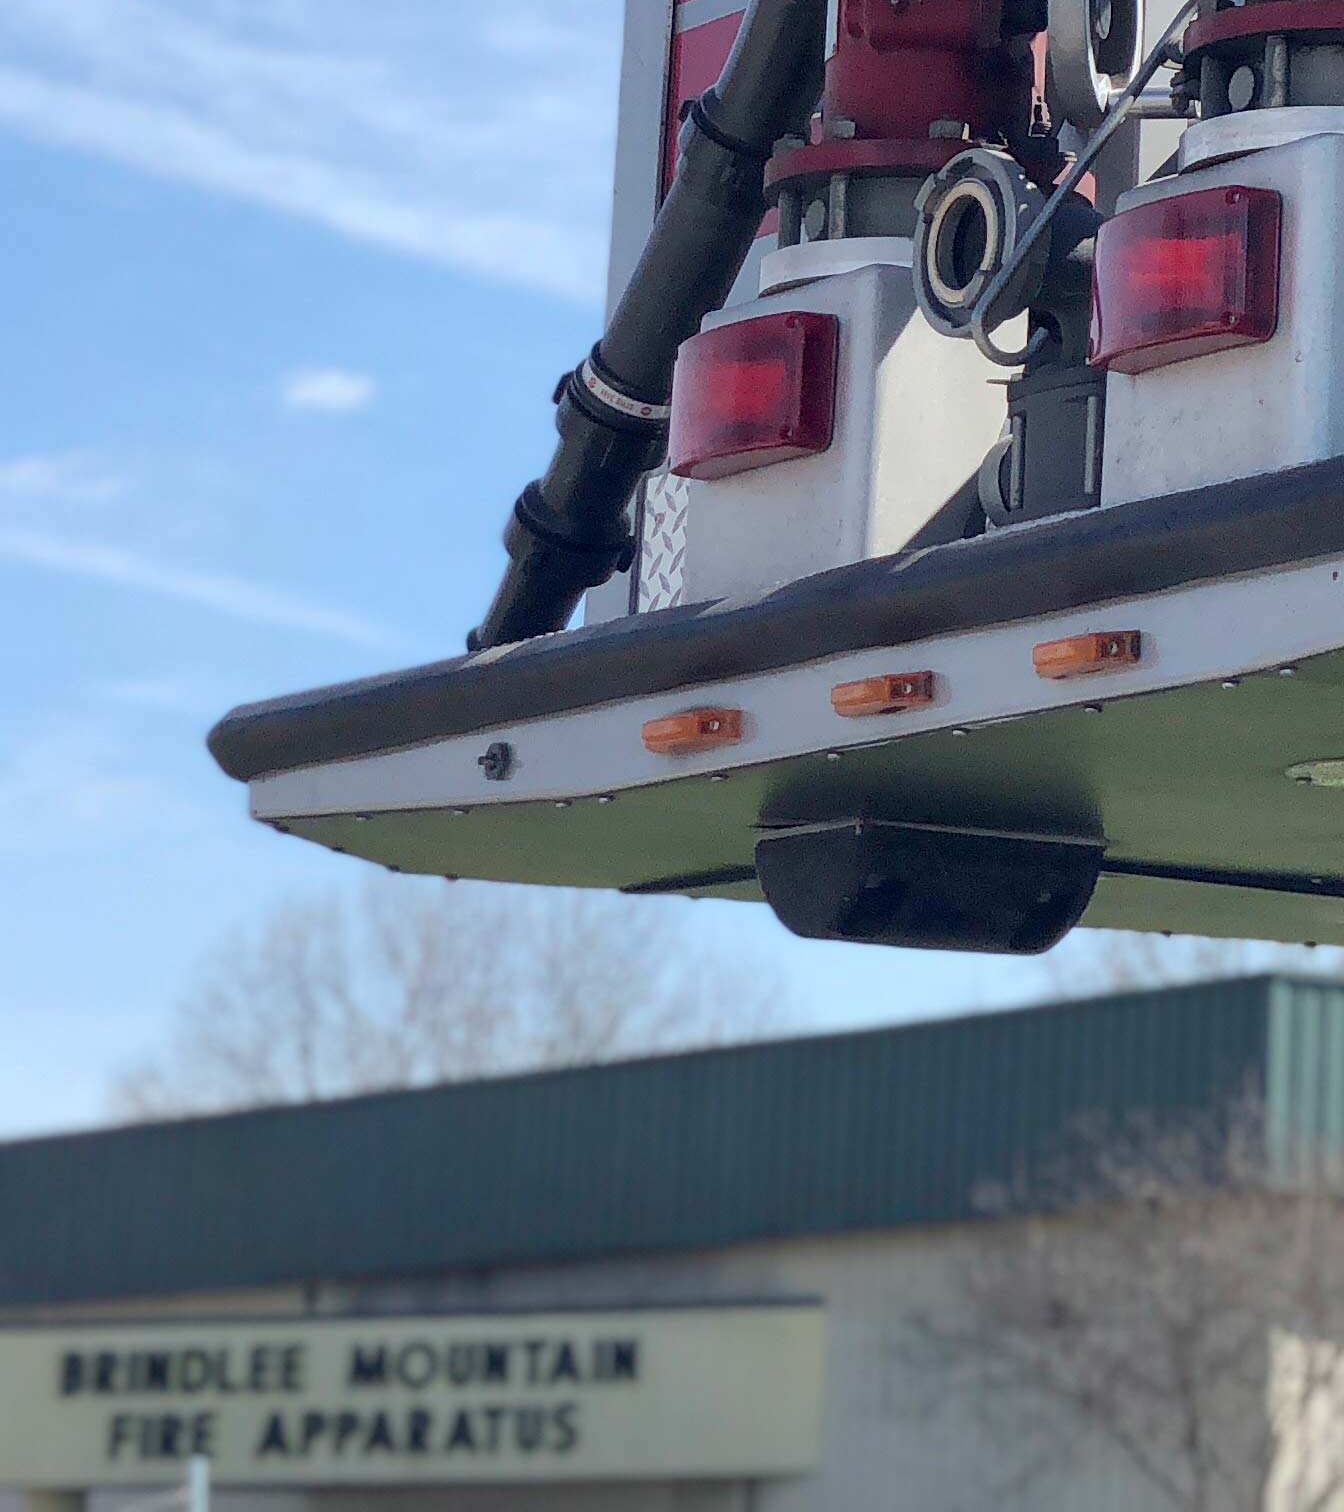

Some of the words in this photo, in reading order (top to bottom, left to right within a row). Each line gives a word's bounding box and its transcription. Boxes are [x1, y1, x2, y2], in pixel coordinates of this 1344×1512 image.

[60, 1342, 308, 1398] BRINDLEE
[349, 1337, 640, 1387] MOUNTAIN
[108, 1409, 216, 1461] FIRE
[256, 1403, 579, 1458] APPARATUS
